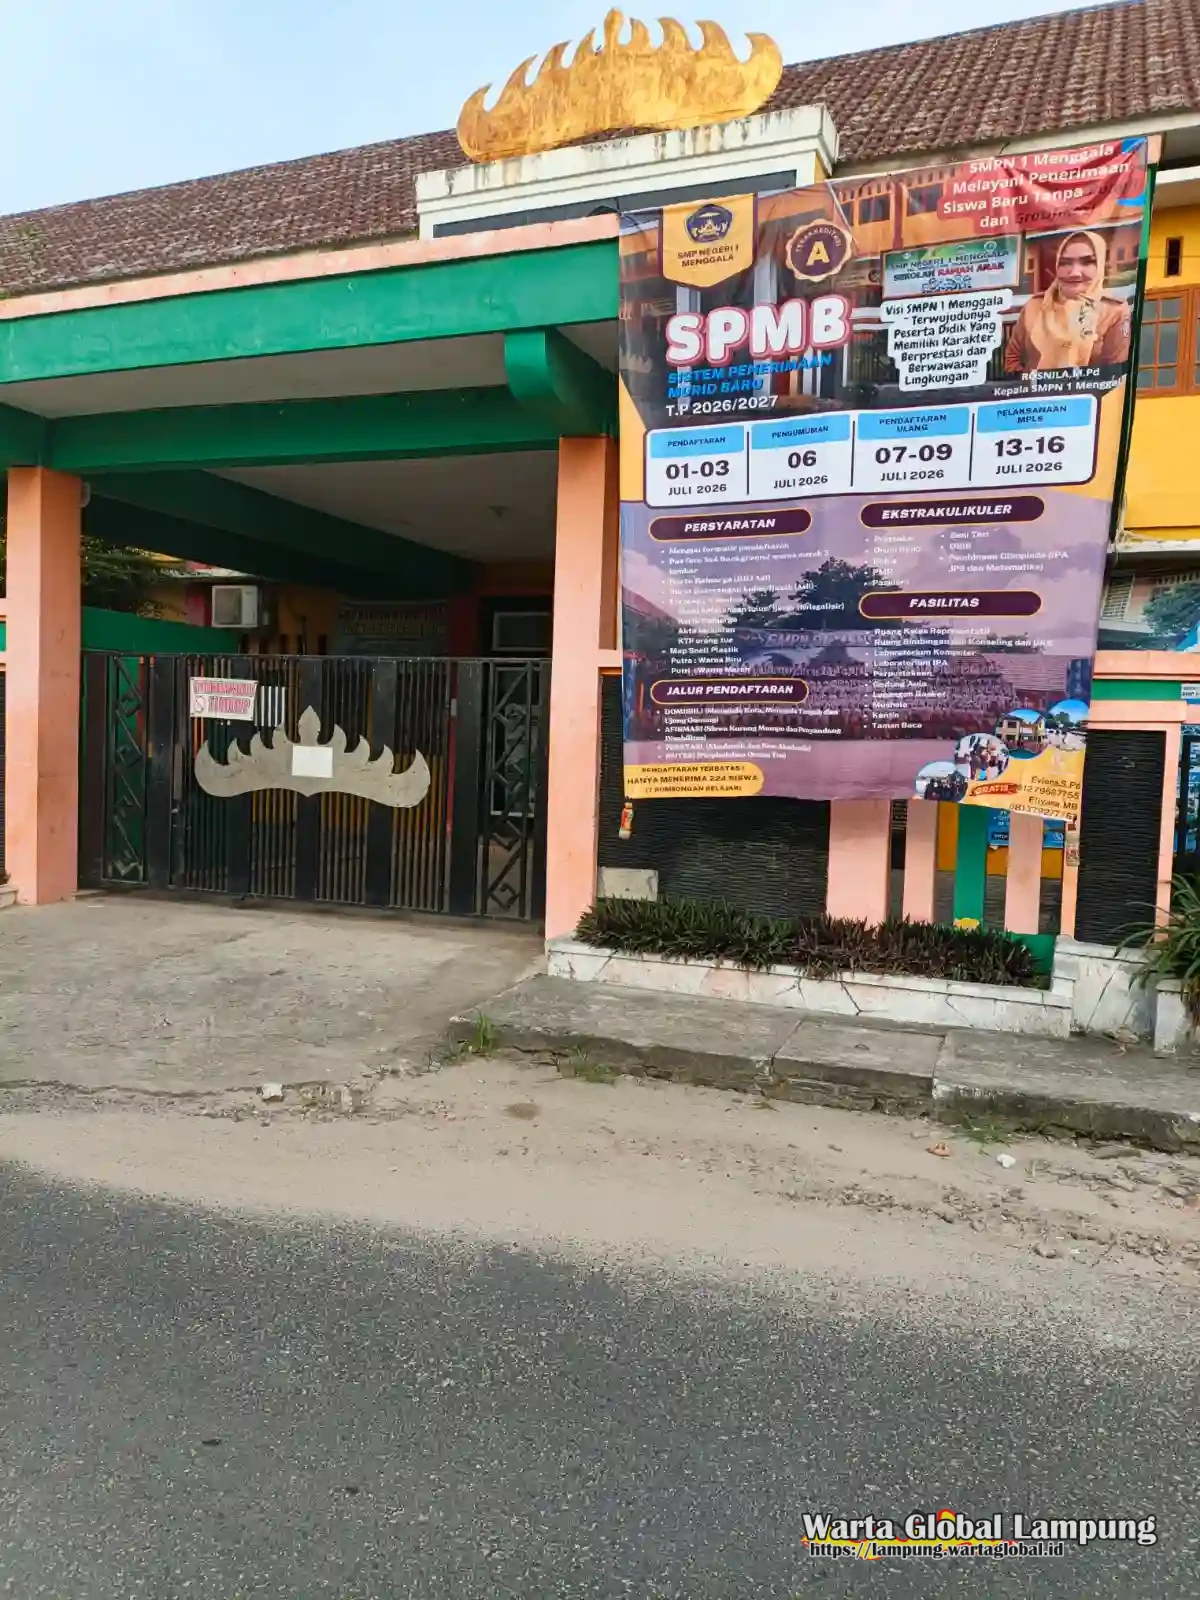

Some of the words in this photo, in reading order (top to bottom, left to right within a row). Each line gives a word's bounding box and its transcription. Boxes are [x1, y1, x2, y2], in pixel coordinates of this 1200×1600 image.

[969, 157, 1015, 175] SMPN
[1021, 156, 1028, 169] 1
[1033, 144, 1114, 166] Menggala
[953, 176, 1024, 195] Melayani
[1029, 162, 1130, 184] Penerimaan
[943, 200, 987, 214] Siswa
[992, 195, 1028, 209] Baru
[1033, 186, 1083, 203] Tanpa
[979, 216, 1009, 229] dan
[677, 250, 699, 260] SMP
[699, 246, 733, 258] NEGERI
[806, 240, 830, 266] A
[681, 254, 734, 268] MENGGALA
[886, 305, 904, 316] Visi
[907, 301, 938, 314] SMPN
[948, 296, 1004, 312] Menggala
[666, 294, 849, 367] SPMB
[894, 328, 935, 340] Peserta
[939, 323, 967, 335] Didik
[970, 322, 996, 335] Yang
[893, 340, 939, 351] Memiliki
[901, 349, 963, 364] Berprestasi
[967, 346, 987, 357] dan
[667, 367, 723, 384] SISTEM
[728, 353, 833, 378] PENERIMAAN
[908, 359, 978, 374] Berwawasan
[904, 372, 969, 386] Lingkungan
[667, 382, 717, 399] MURID
[720, 377, 764, 395] BARU
[994, 385, 1029, 397] Kepala
[1032, 383, 1064, 394] SMPN
[665, 402, 690, 417] T.P
[692, 395, 779, 416] 2026/2027
[996, 405, 1067, 417] PELAKSANAAN
[879, 414, 947, 426] PENDAFTARAN
[1017, 415, 1044, 424] MPLS
[896, 423, 928, 433] ULANG
[667, 436, 726, 448] PENDAFTARAN
[994, 435, 1065, 457] 13-16
[788, 450, 817, 469] 06
[875, 443, 953, 464] 07-09
[665, 460, 730, 480] 01-03
[880, 471, 907, 482] JULI
[910, 469, 944, 480] 2026
[995, 464, 1022, 475] JULI
[1025, 462, 1062, 473] 2026
[773, 479, 796, 489] JULI
[798, 475, 828, 487] 2026
[668, 487, 692, 496] JULI
[696, 483, 727, 494] 2026
[881, 504, 1012, 521] EKSTRAKULIKULER
[684, 518, 776, 533] PERSYARATAN
[909, 597, 980, 608] FASILITAS
[666, 686, 703, 696] JALUR
[705, 684, 794, 696] PENDAFTARAN
[627, 777, 658, 785] HANYA
[660, 775, 707, 784] MENERIMA
